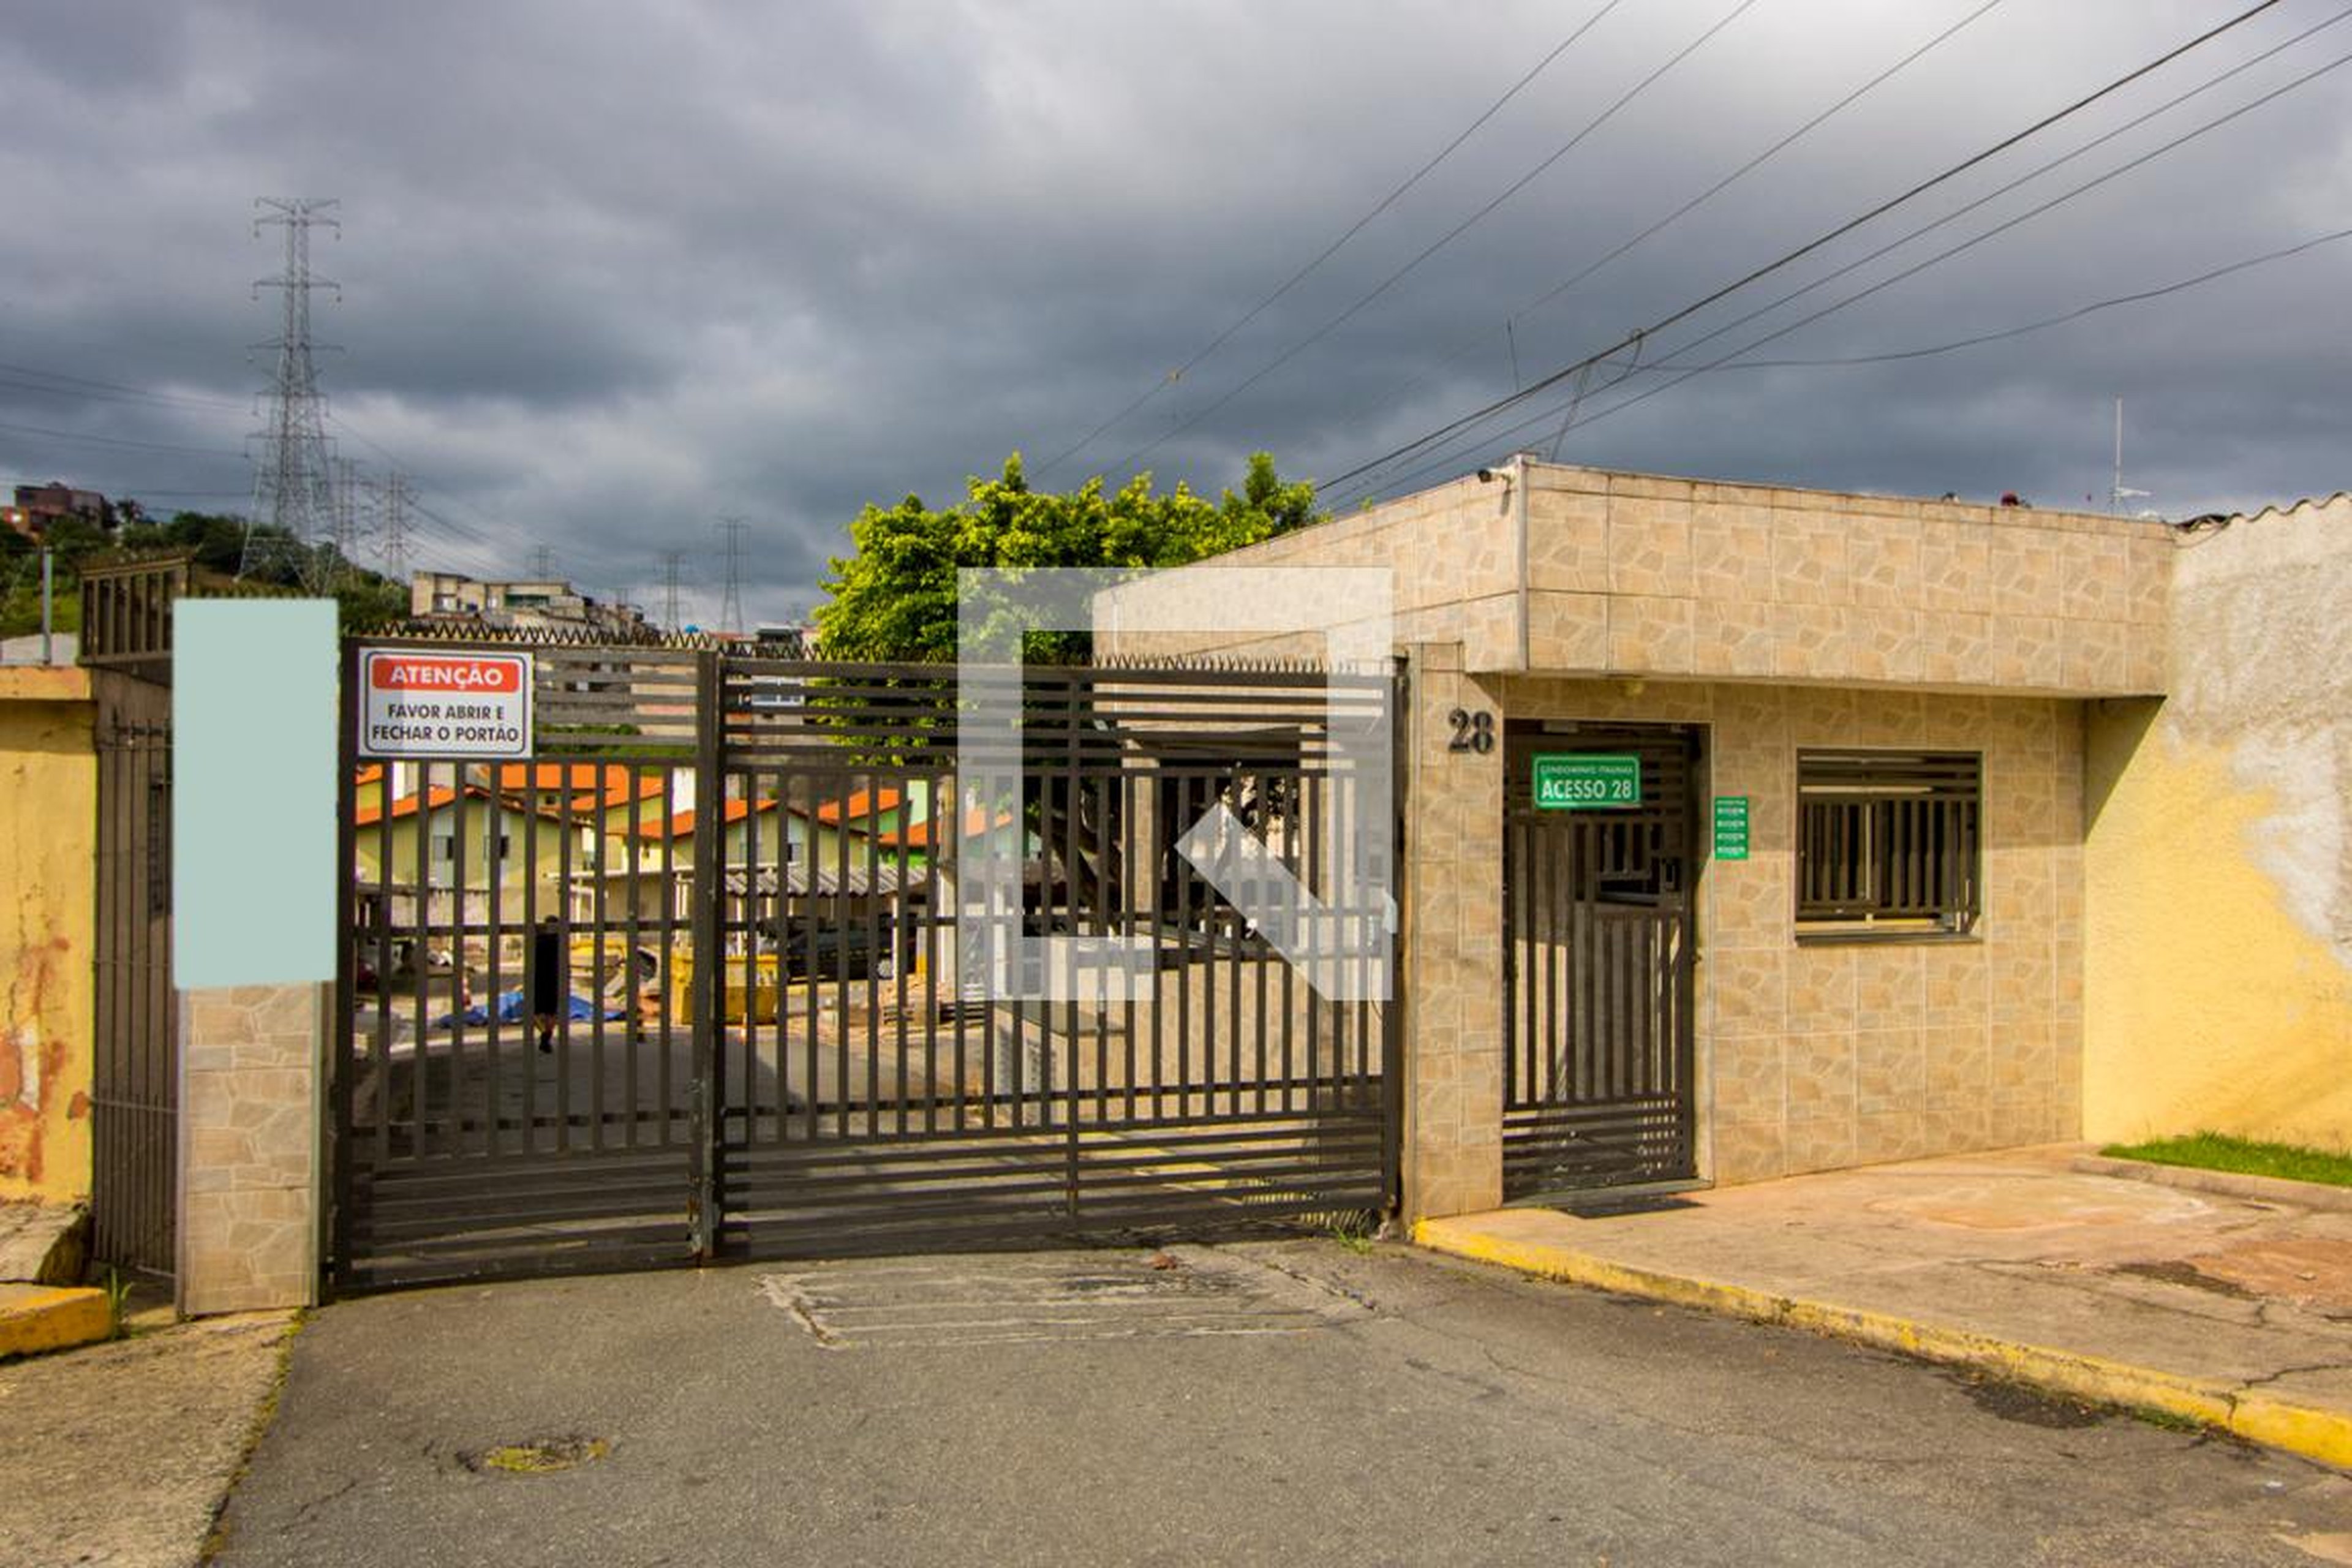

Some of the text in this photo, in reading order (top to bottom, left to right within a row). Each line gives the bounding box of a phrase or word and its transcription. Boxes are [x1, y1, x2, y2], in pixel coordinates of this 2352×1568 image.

[391, 663, 503, 688] ATENÇÃO
[388, 704, 504, 720] FAVOR ABRIR E
[372, 726, 432, 740] FECHAR
[437, 726, 450, 740] O
[1448, 709, 1493, 755] 28
[1542, 779, 1632, 799] ACESSO 28
